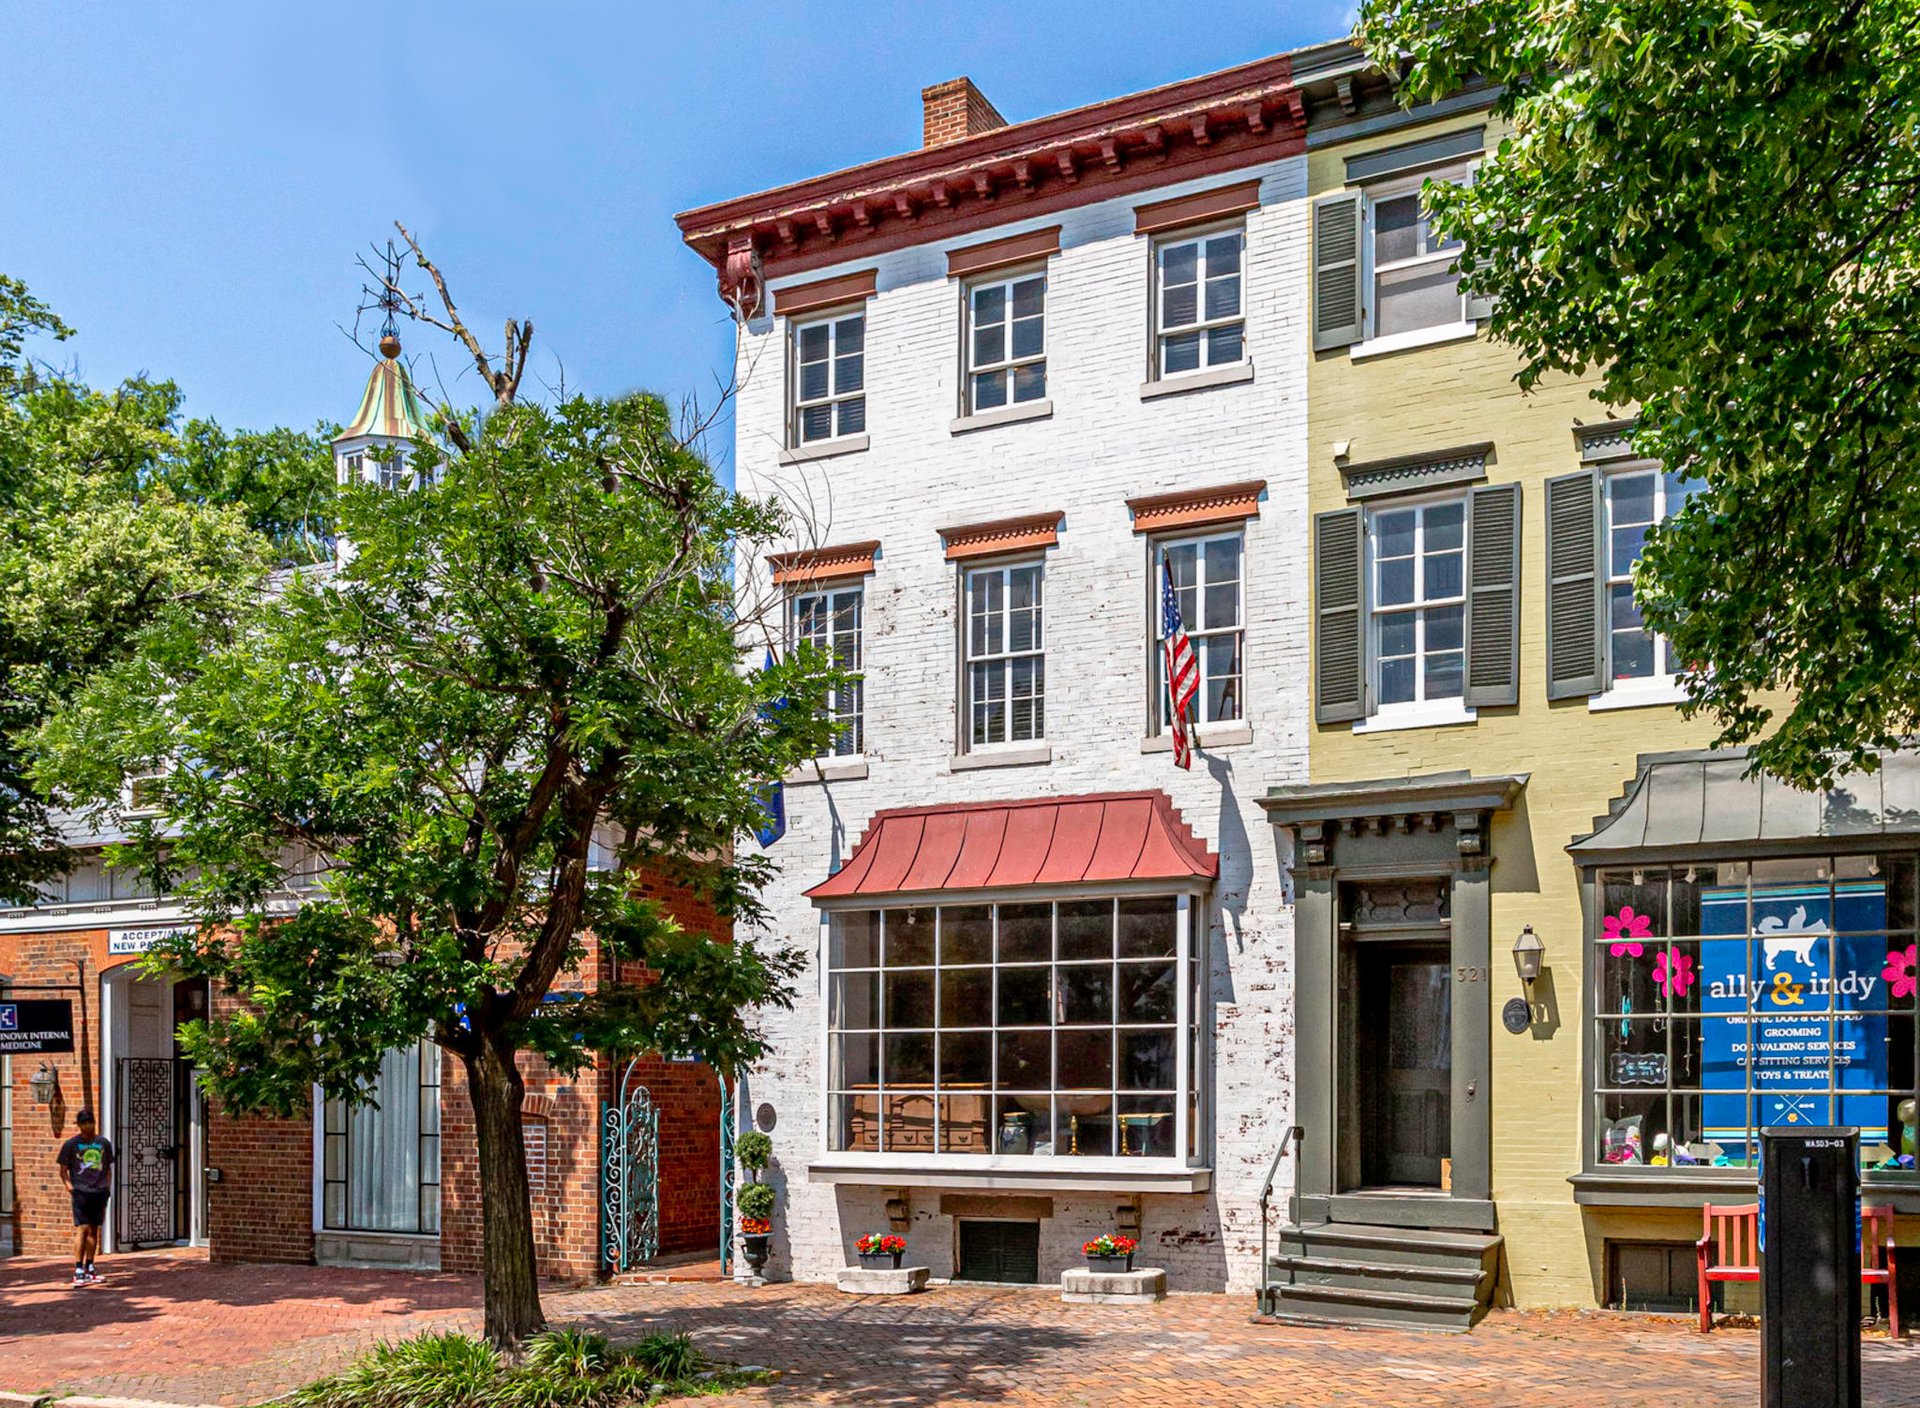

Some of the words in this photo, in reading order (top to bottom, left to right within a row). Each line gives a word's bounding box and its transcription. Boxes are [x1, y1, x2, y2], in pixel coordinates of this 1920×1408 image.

[113, 941, 136, 950] NEW
[1457, 966, 1487, 983] 321
[1710, 974, 1766, 1003] ally
[1771, 972, 1804, 1006] &
[1809, 970, 1877, 1000] indy
[0, 1031, 29, 1041] INOVA
[29, 1031, 70, 1040] INTERNAL
[1764, 1027, 1821, 1037] GROOMING
[0, 1041, 42, 1050] MEDICINE
[1756, 1041, 1805, 1051] WALKING
[1807, 1041, 1856, 1051] SERVICES
[1736, 1057, 1758, 1066] CT
[1758, 1056, 1801, 1066] SITTING
[1802, 1055, 1851, 1066] SERVCES
[1754, 1071, 1781, 1080] TOYS
[1783, 1071, 1792, 1080] &
[1792, 1070, 1831, 1080] TREATS
